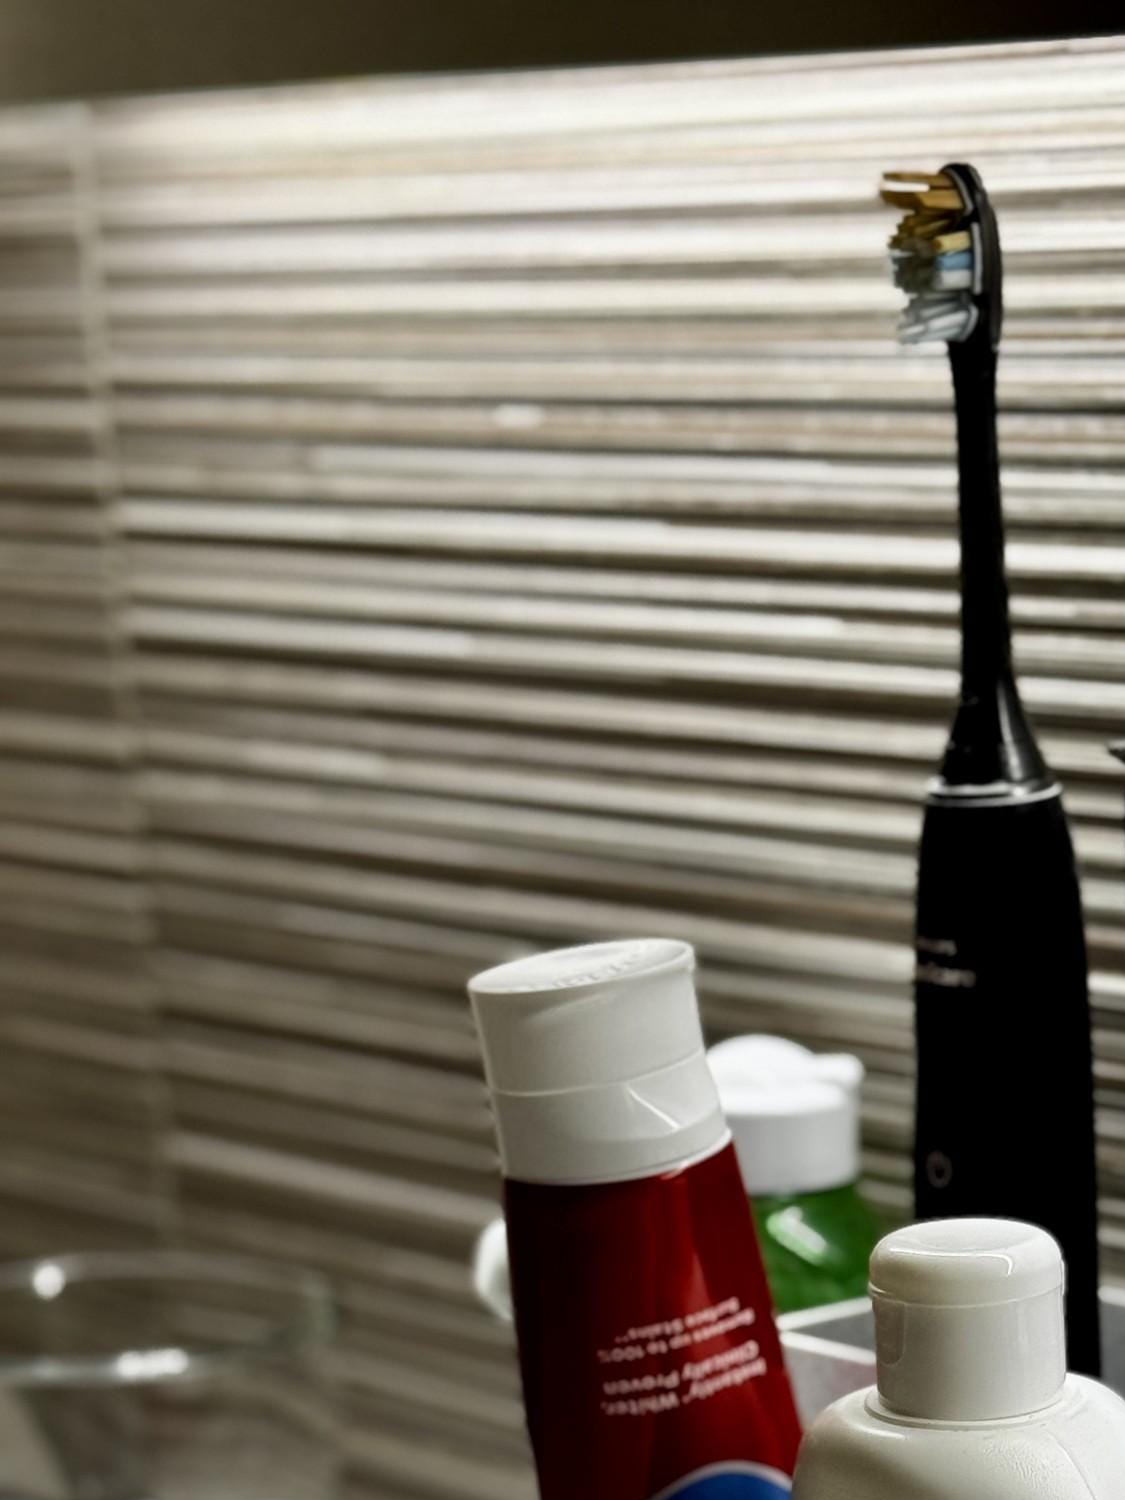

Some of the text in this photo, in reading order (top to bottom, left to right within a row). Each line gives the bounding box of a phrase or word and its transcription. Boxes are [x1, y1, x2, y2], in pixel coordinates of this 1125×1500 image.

[684, 1296, 740, 1328] Surface
[646, 1339, 668, 1355] to
[668, 1332, 692, 1350] up
[603, 1339, 760, 1395] Clinically Proven
